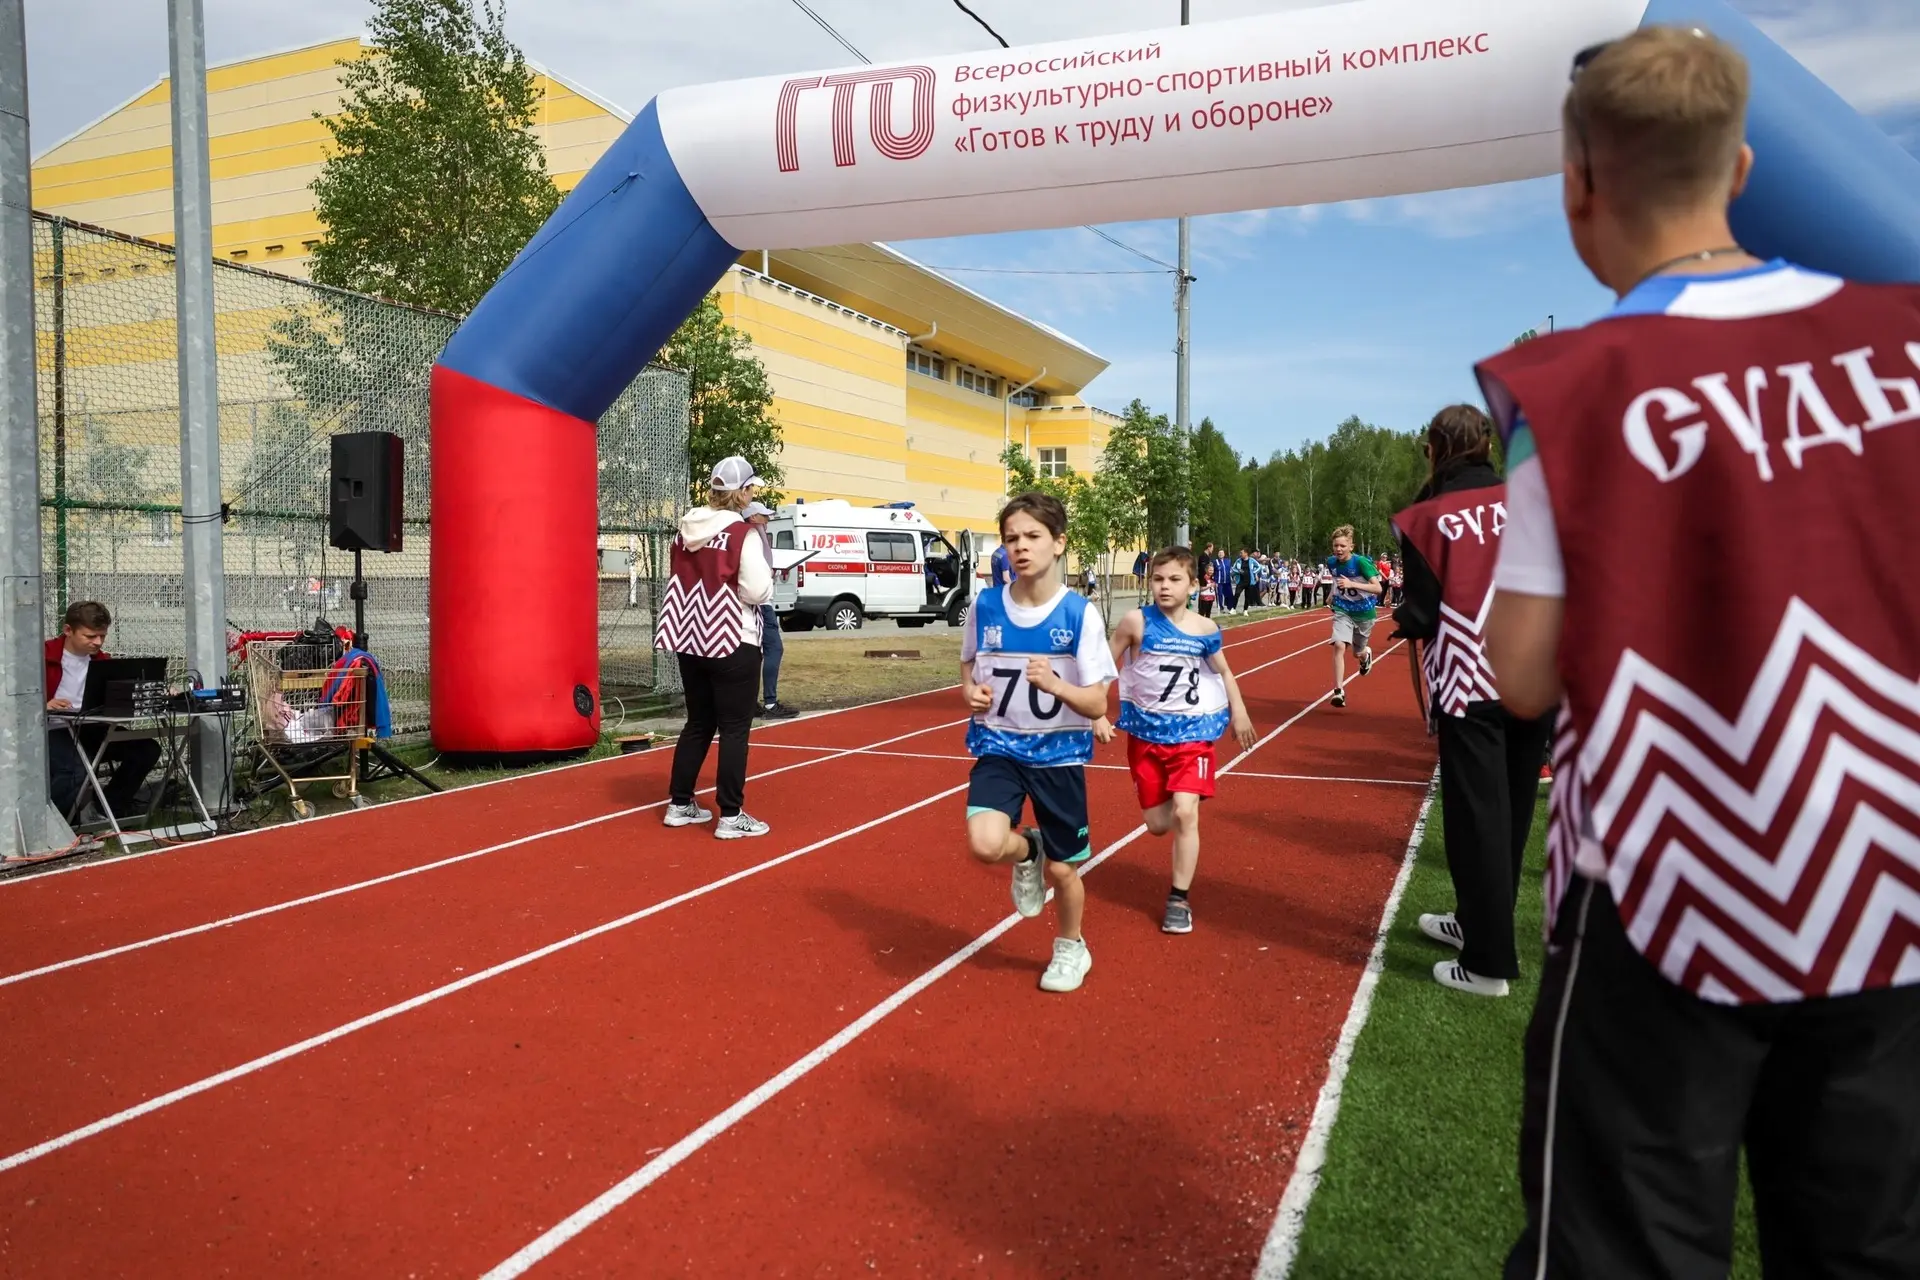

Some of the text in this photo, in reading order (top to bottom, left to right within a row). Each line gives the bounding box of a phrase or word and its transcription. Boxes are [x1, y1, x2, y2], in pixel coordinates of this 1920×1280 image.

[951, 32, 1489, 122] физкультурно-спортивный комплекс
[954, 42, 1161, 82] Всероссийский
[776, 65, 936, 172] ГТО
[954, 95, 1333, 153] «Готов к труду и обороне»
[1621, 340, 1920, 483] СУДЬ
[811, 534, 835, 549] 103
[1437, 501, 1508, 545] СУД
[827, 563, 848, 571] СКОРАЯ
[1159, 664, 1200, 706] 78
